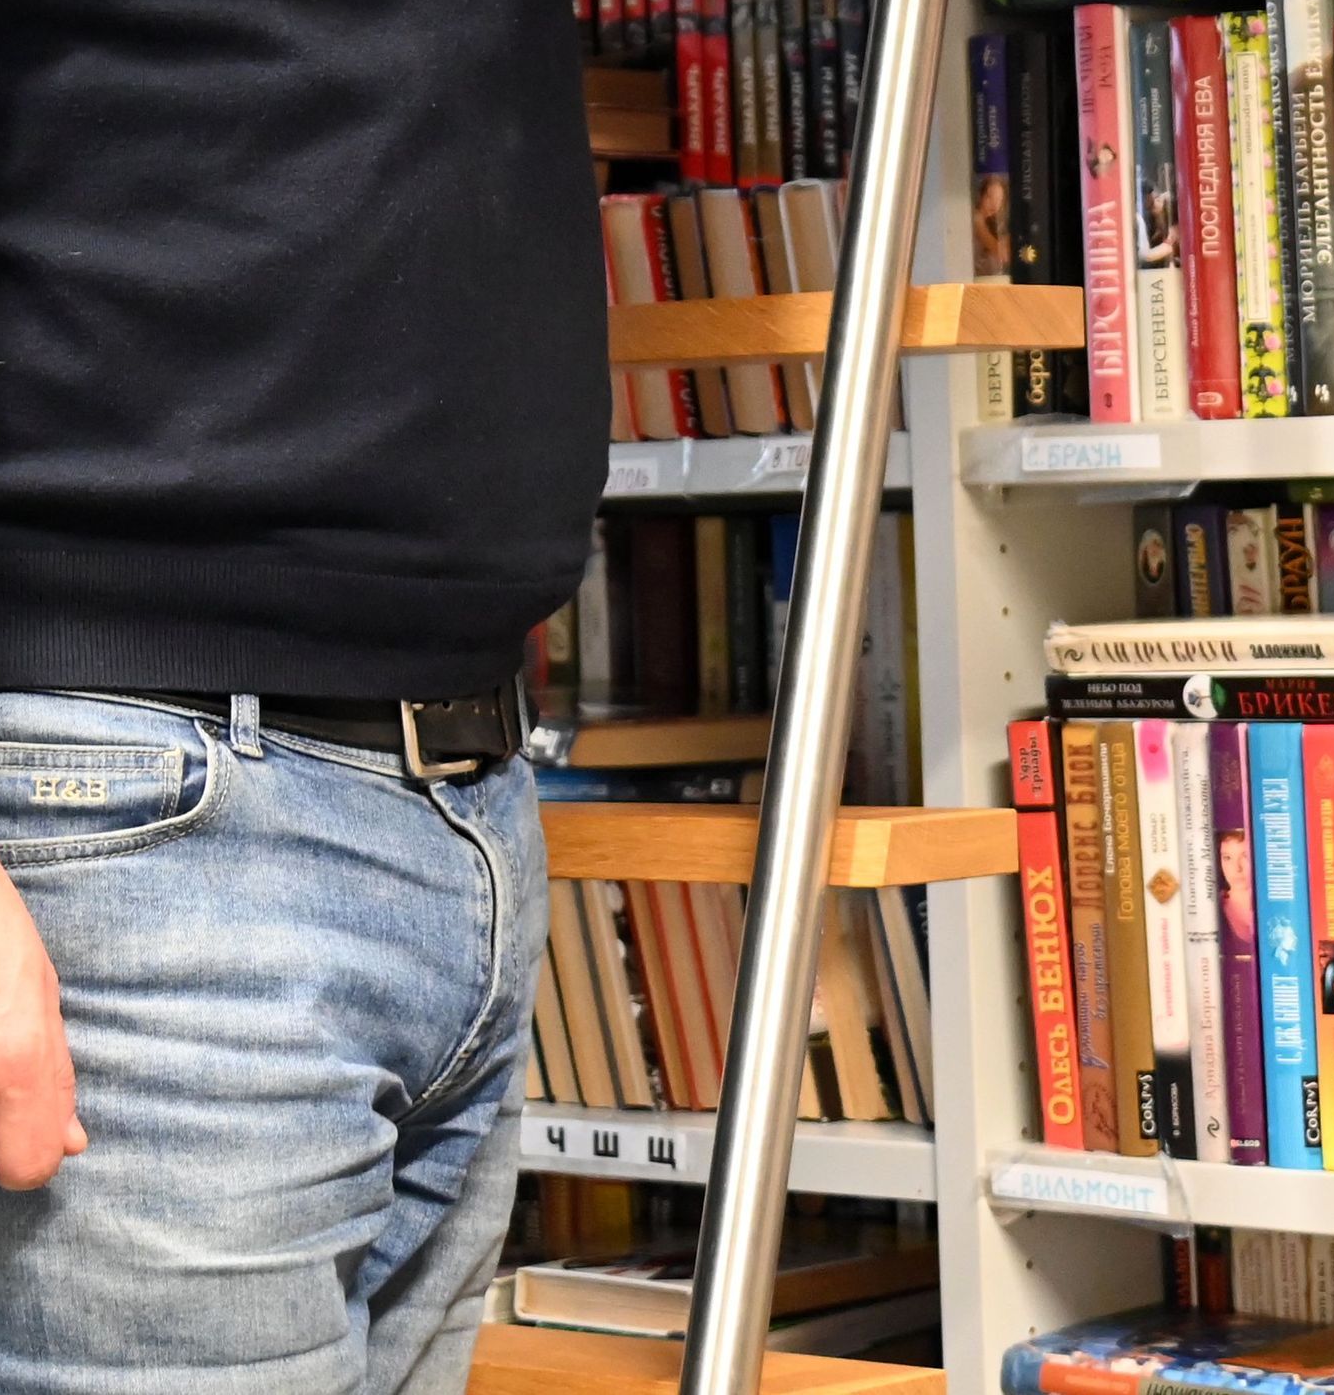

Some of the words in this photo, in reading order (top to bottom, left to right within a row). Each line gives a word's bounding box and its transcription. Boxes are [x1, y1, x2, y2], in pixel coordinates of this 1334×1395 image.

[1194, 75, 1213, 115] ЕВА
[1291, 91, 1310, 194] БАРЬЕРИ
[1310, 84, 1333, 264] ЭЛЕГАНТНОСТЬ
[1196, 124, 1220, 256] ПОСЛЕДНЯЯ
[1088, 201, 1125, 377] БЕРСЕНЕВА
[1296, 201, 1316, 322] МЮРИЕЛЬ
[1150, 278, 1169, 400] БЕРСЕНЕВА
[1091, 640, 1168, 666] САНДРА
[1173, 639, 1238, 664] БРАУН
[1087, 682, 1115, 695] НЕБО
[1119, 682, 1143, 694] ПОД
[1117, 696, 1176, 710] АБАЖУРОМ
[1017, 747, 1031, 783] Удар
[1064, 743, 1096, 806] Блок
[1110, 742, 1126, 788] отца
[1114, 792, 1131, 851] моего
[1103, 834, 1114, 874] Елена
[1115, 855, 1135, 921] Голова
[1027, 865, 1066, 1013] БЕНЮХ
[1199, 956, 1213, 1030] Борисова
[1203, 1034, 1217, 1100] Ариадна
[547, 1126, 565, 1152] Ч
[593, 1130, 619, 1157] Ш
[648, 1136, 676, 1171] Щ
